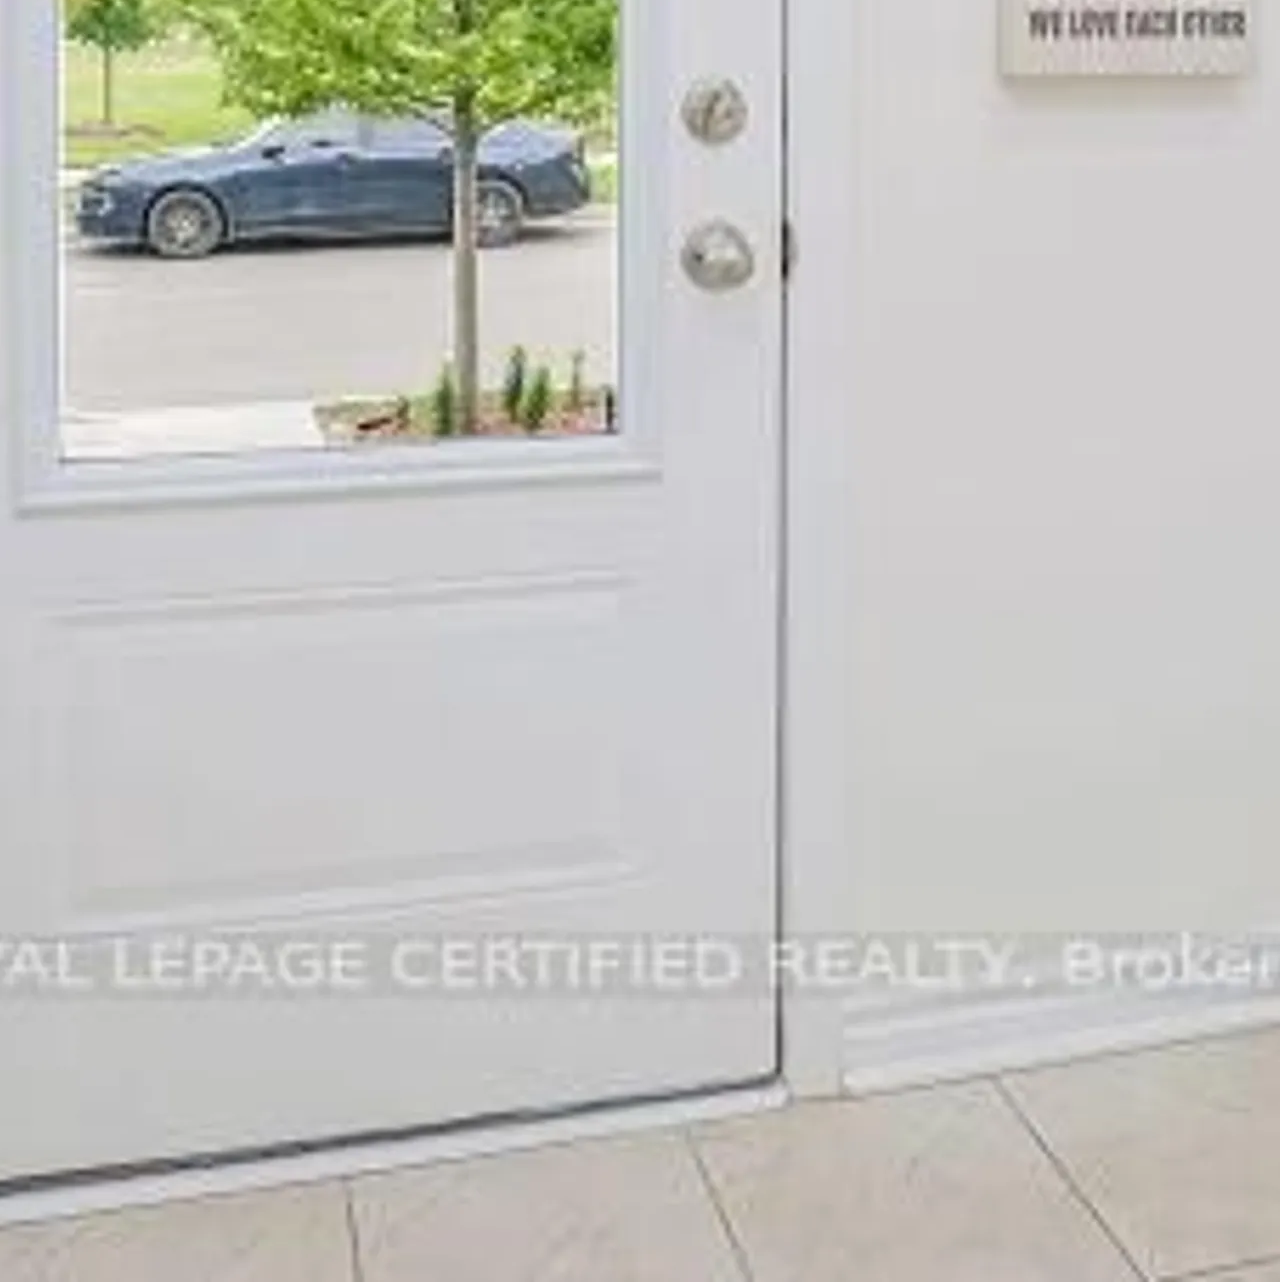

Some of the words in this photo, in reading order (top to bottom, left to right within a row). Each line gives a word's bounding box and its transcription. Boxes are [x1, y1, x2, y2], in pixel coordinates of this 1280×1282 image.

[1029, 9, 1061, 40] WE
[1069, 9, 1118, 39] LOVE
[1125, 9, 1177, 38] EACH
